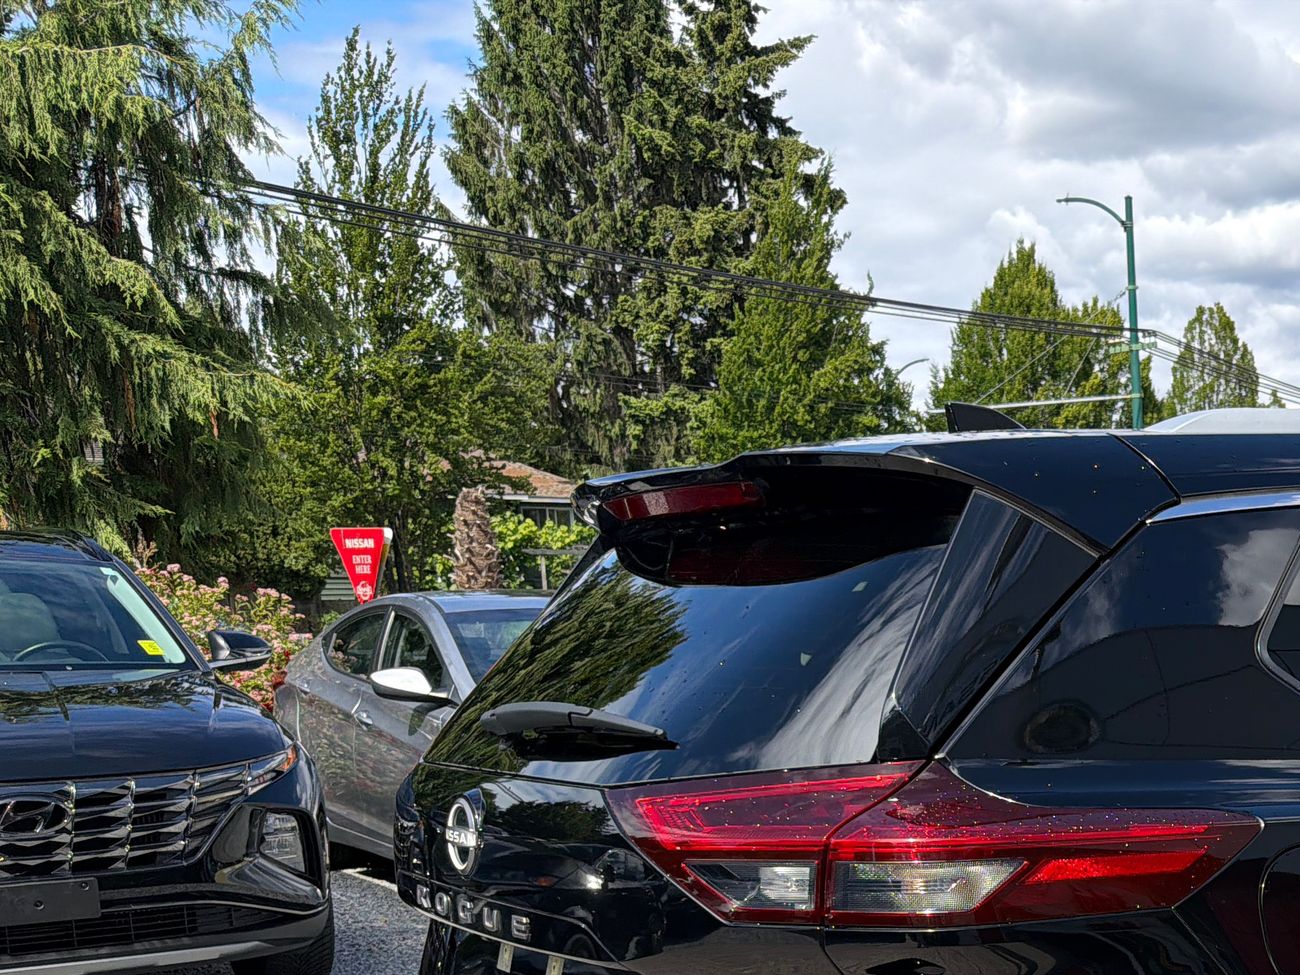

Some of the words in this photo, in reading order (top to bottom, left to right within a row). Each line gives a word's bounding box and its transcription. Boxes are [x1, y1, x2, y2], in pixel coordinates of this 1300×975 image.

[345, 538, 375, 549] NISSAN
[352, 554, 372, 564] ENTER
[355, 564, 371, 574] HERE
[416, 884, 532, 940] ROGUE
